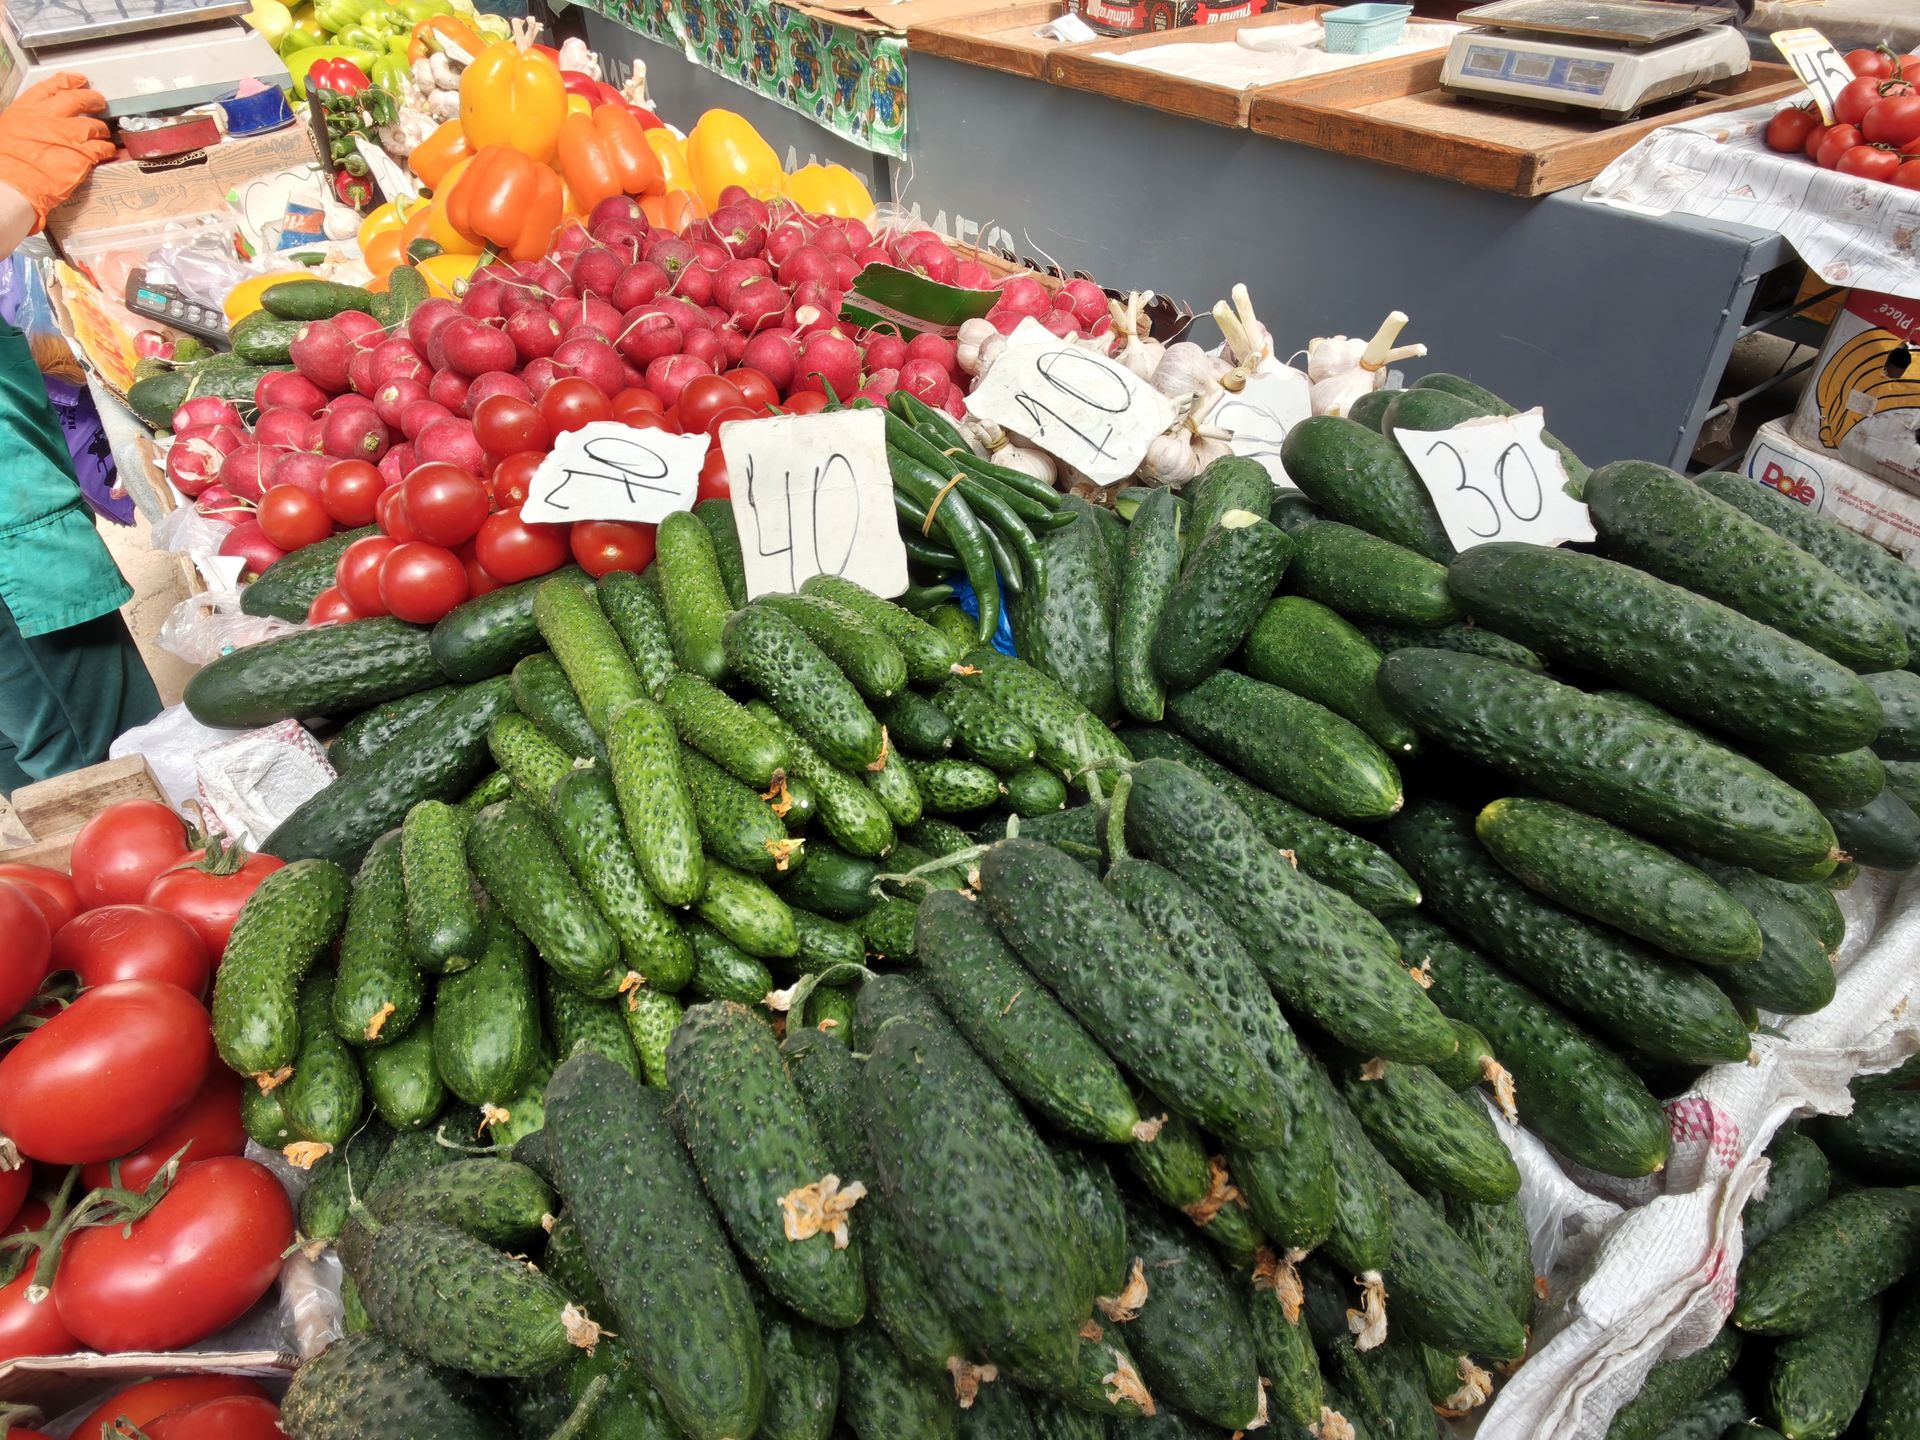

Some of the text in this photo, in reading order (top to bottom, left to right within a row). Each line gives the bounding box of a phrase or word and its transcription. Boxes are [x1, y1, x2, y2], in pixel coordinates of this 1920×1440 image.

[1095, 4, 1136, 27] Admira
[1879, 303, 1914, 330] Place
[544, 436, 682, 510] 70
[1426, 440, 1543, 538] 30
[1761, 461, 1816, 503] Dole
[746, 453, 860, 594] 40
